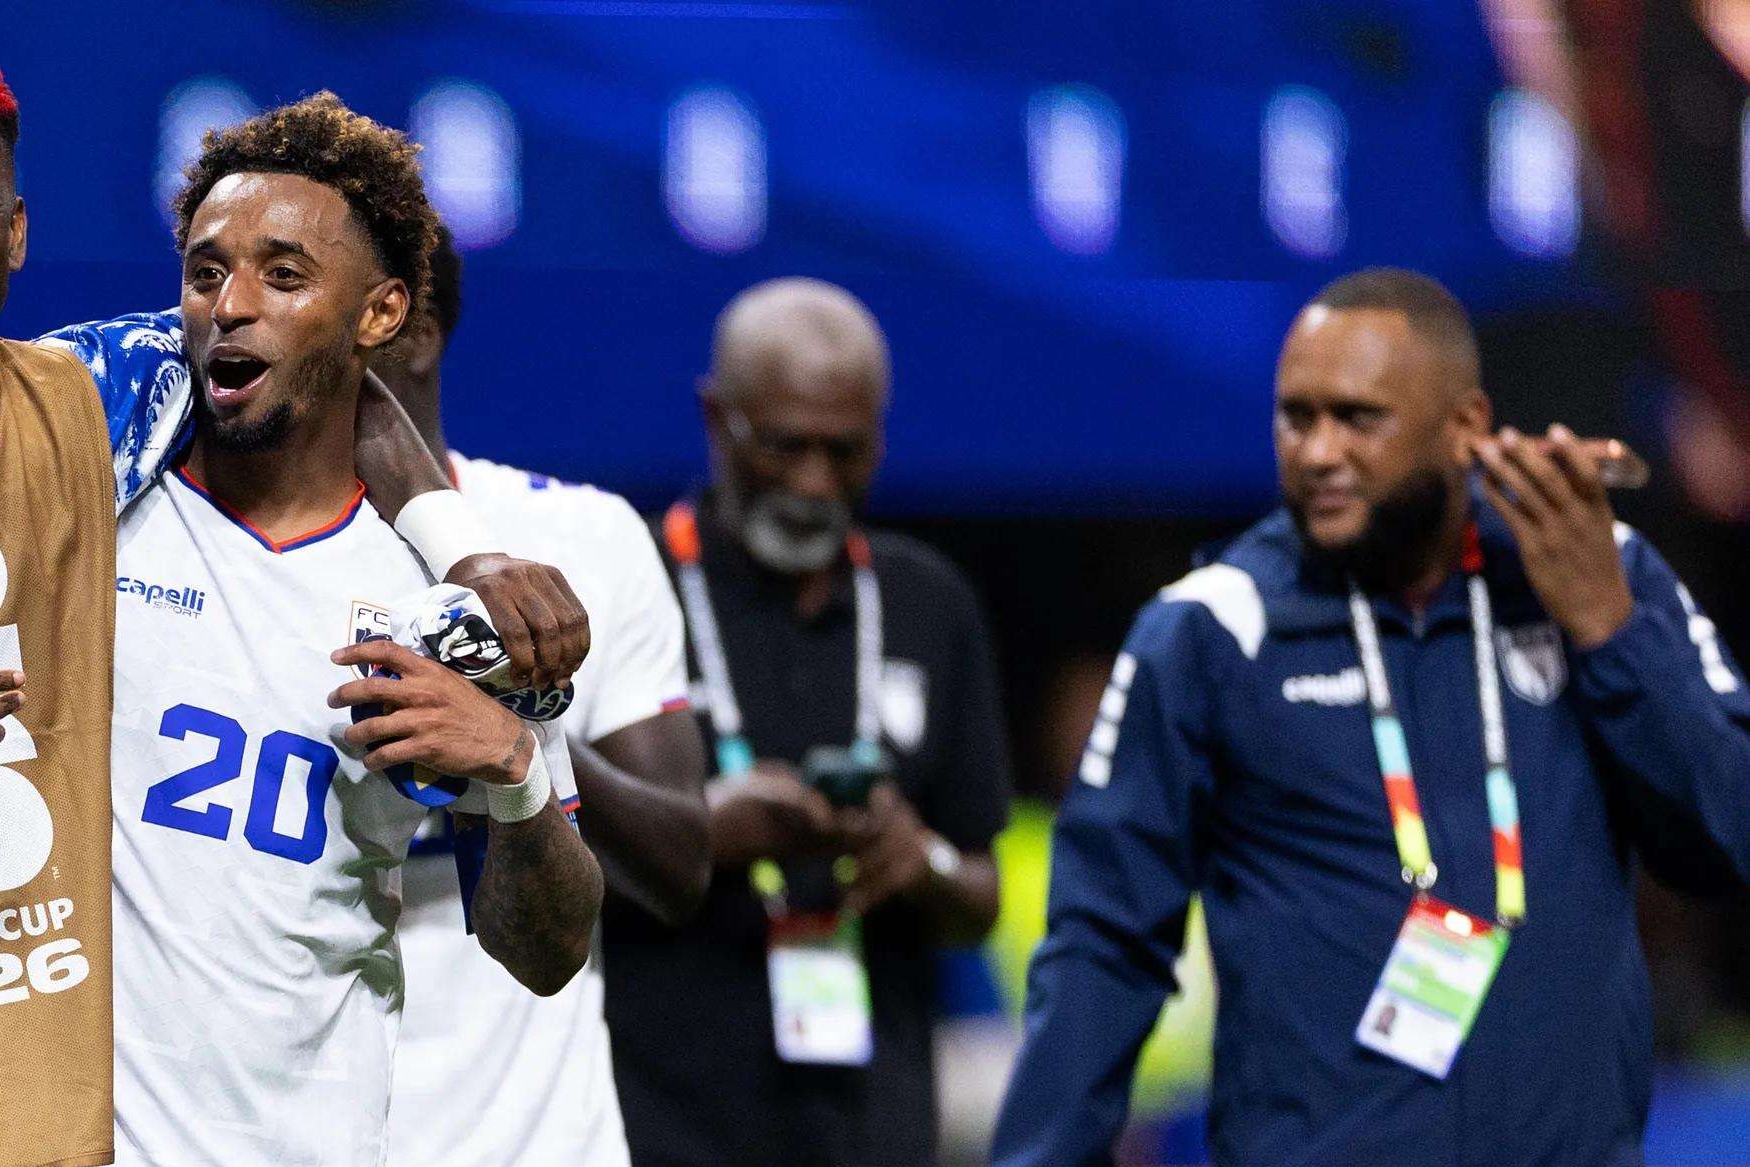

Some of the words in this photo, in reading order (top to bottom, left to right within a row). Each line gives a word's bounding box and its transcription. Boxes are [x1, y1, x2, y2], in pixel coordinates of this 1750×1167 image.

[115, 577, 205, 611] capelli
[357, 607, 389, 626] FC
[141, 703, 339, 865] 20
